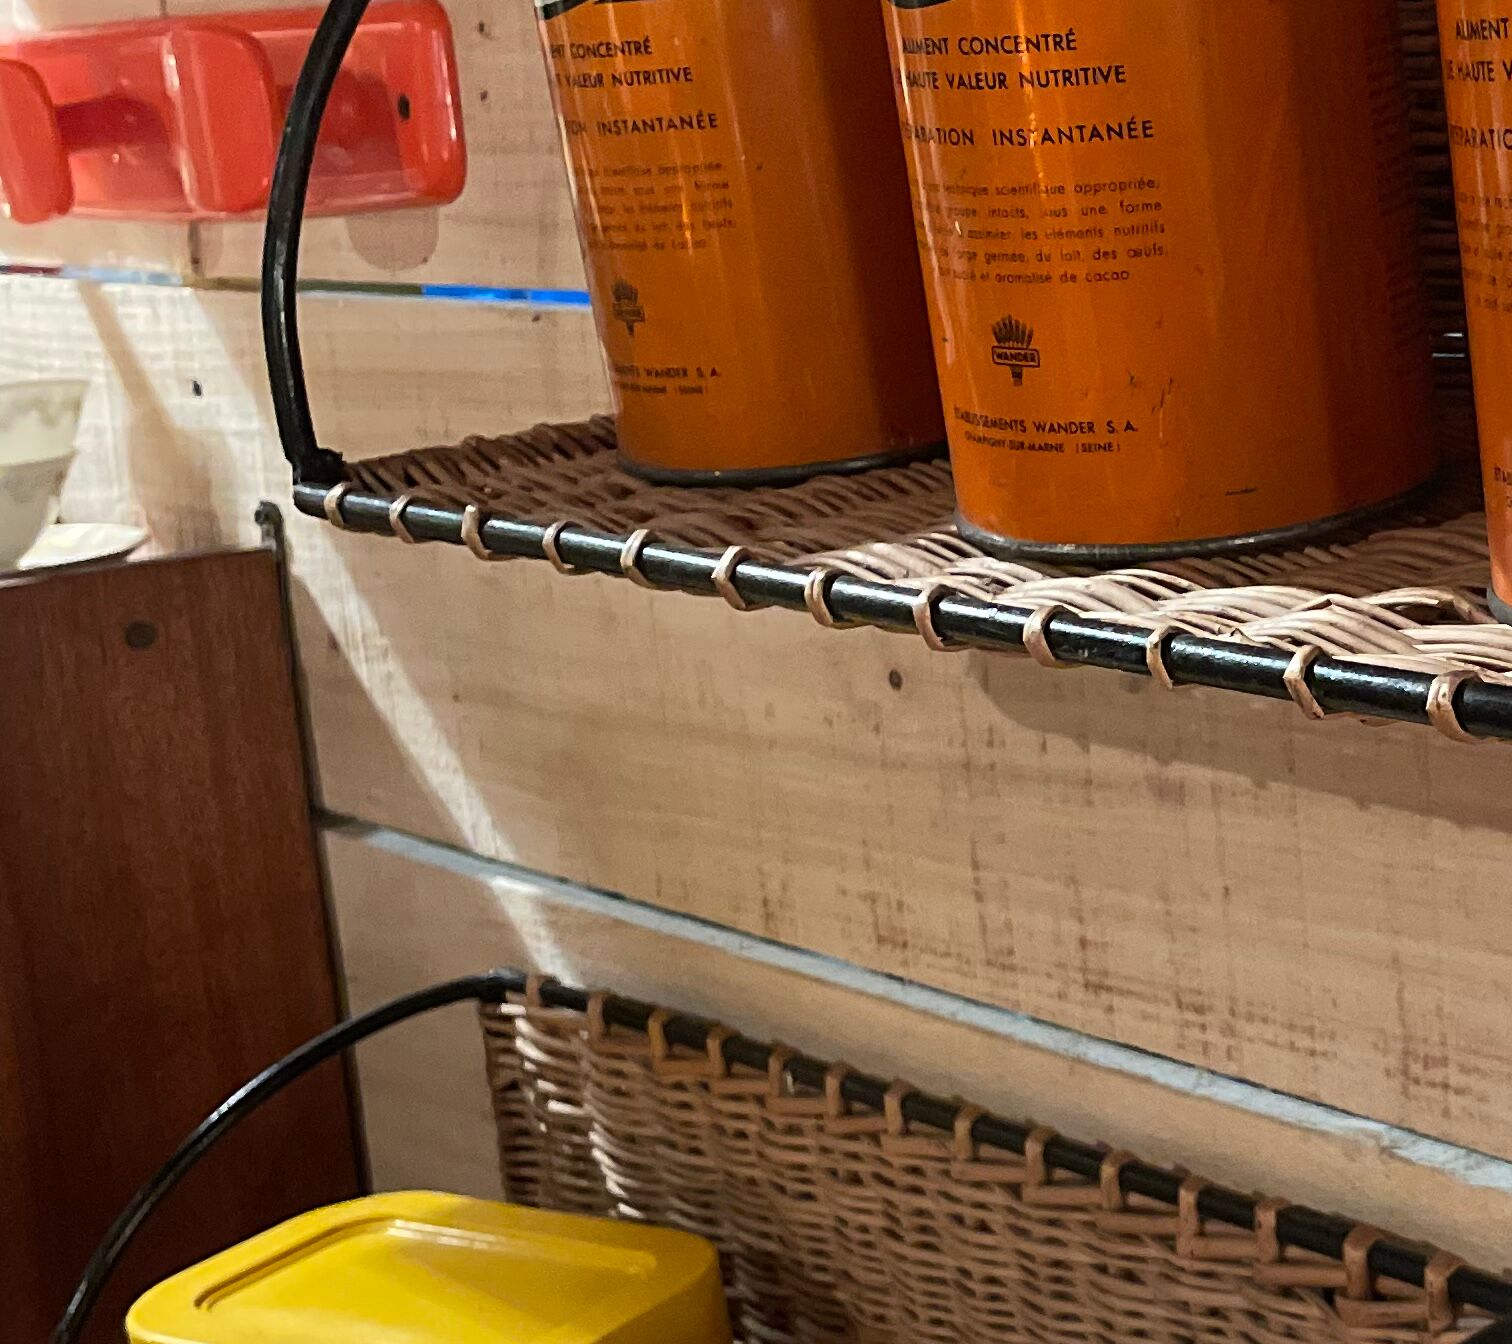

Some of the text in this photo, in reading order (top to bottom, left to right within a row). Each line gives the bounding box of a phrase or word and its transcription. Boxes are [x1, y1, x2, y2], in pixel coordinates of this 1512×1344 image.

[957, 27, 1078, 56] CONCENTRÉ
[1455, 17, 1510, 42] ALIMENT
[612, 66, 694, 88] NUTRITIVE
[946, 70, 1009, 90] VALEUR
[1018, 64, 1127, 89] NUTRITIVE
[1456, 60, 1495, 83] HAUTE
[597, 109, 719, 137] INSTANTANÉE
[1093, 247, 1117, 261] des
[1033, 421, 1096, 435] WANDER
